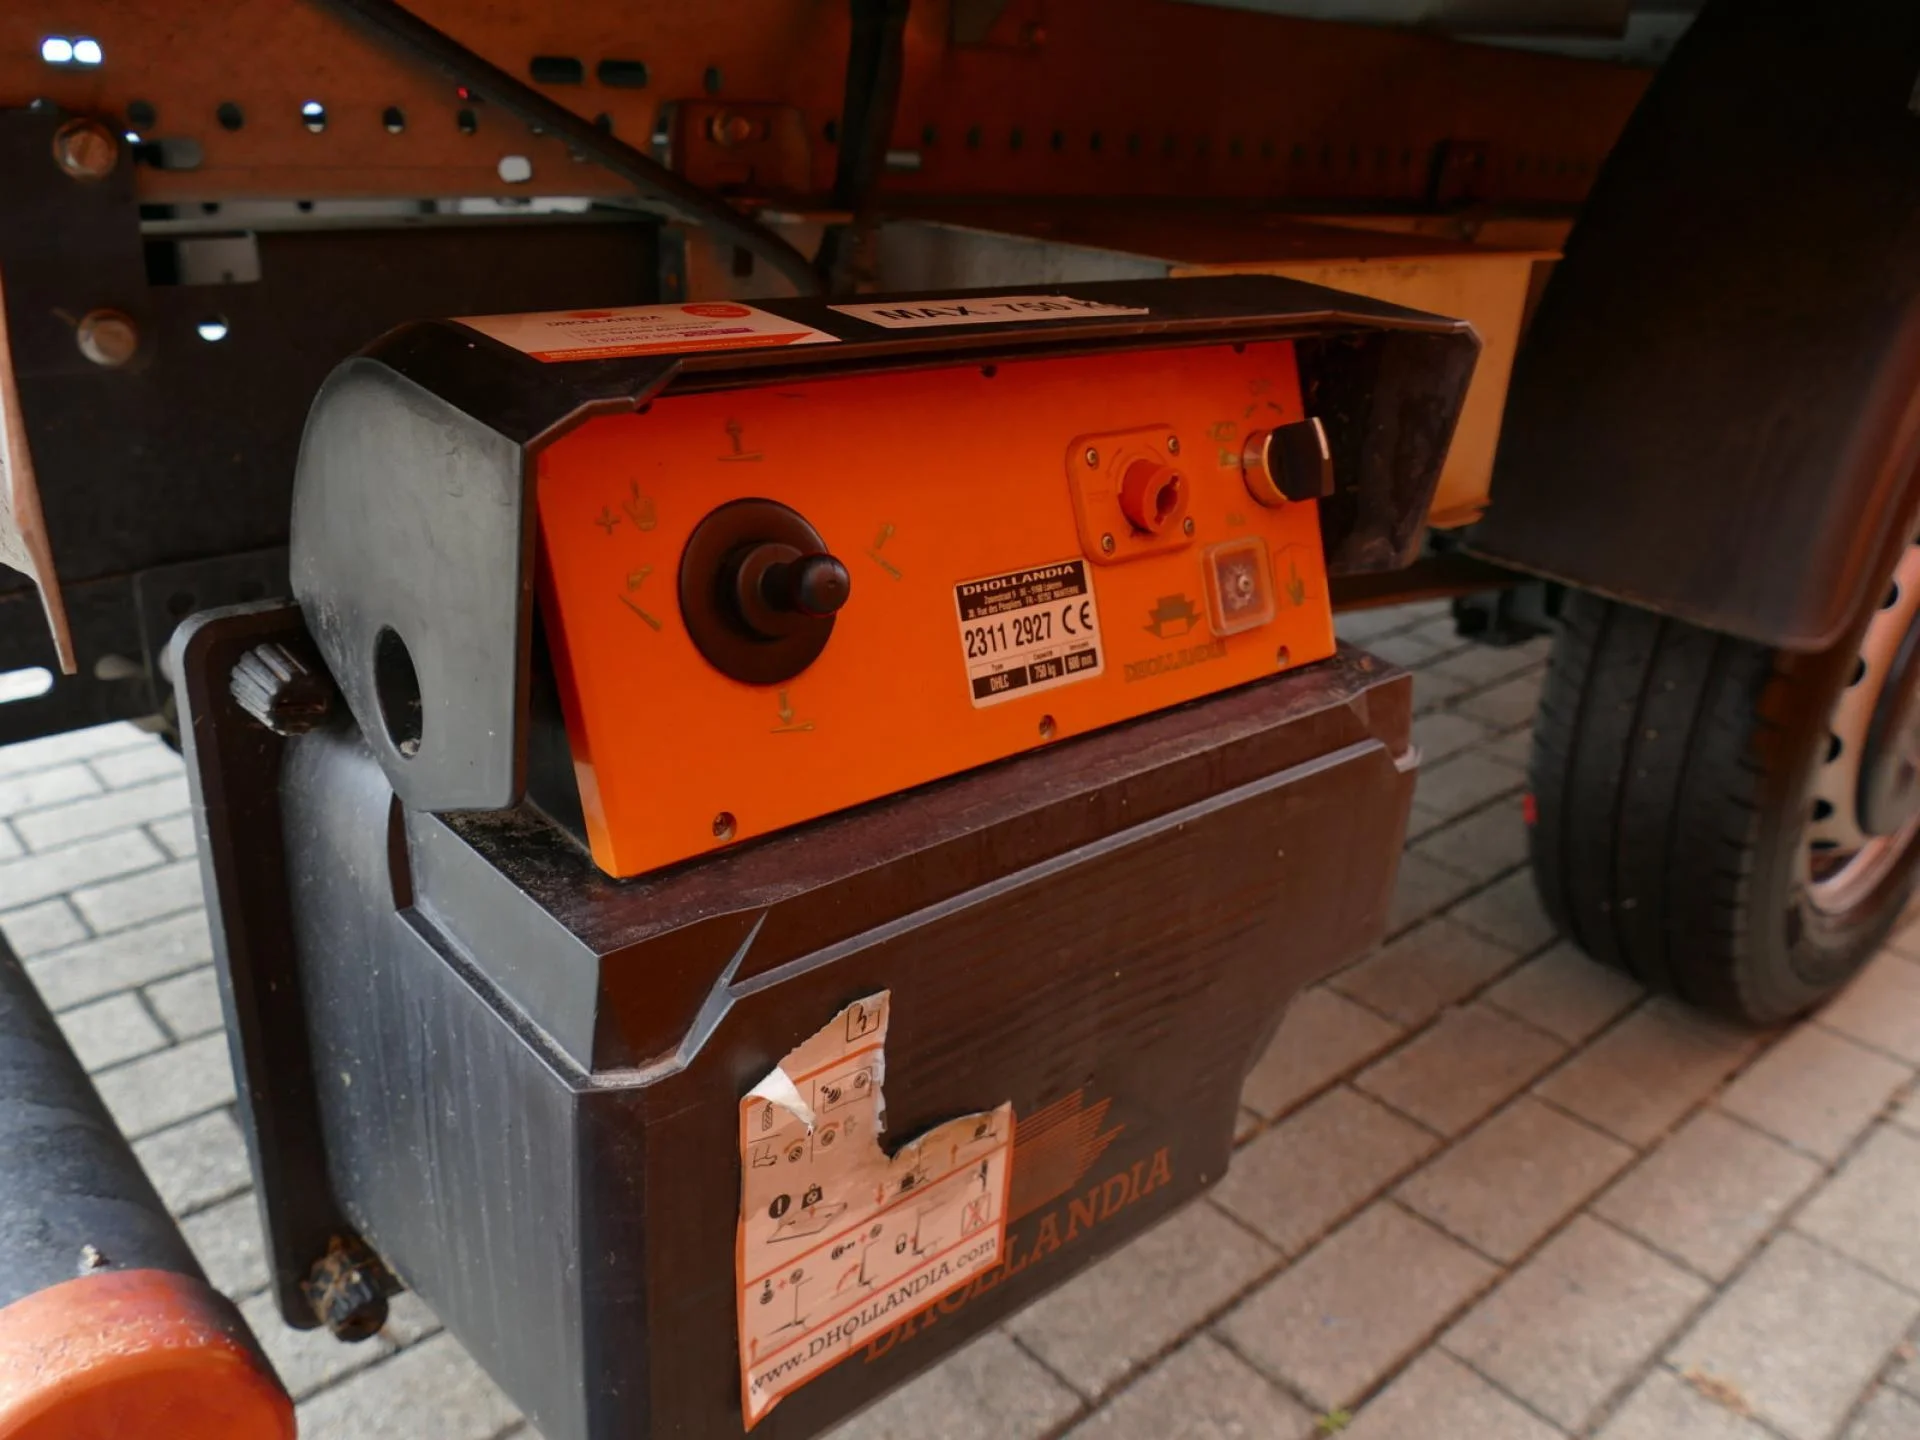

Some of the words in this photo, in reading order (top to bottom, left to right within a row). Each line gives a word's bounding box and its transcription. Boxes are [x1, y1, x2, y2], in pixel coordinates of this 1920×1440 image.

[873, 305, 997, 321] MAX.
[1000, 301, 1073, 314] 750
[962, 564, 1074, 596] DHOLLANDIA
[965, 622, 1007, 659] 2311
[1012, 611, 1052, 648] 2927
[750, 1237, 996, 1395] www.DHOLLANDIA.com
